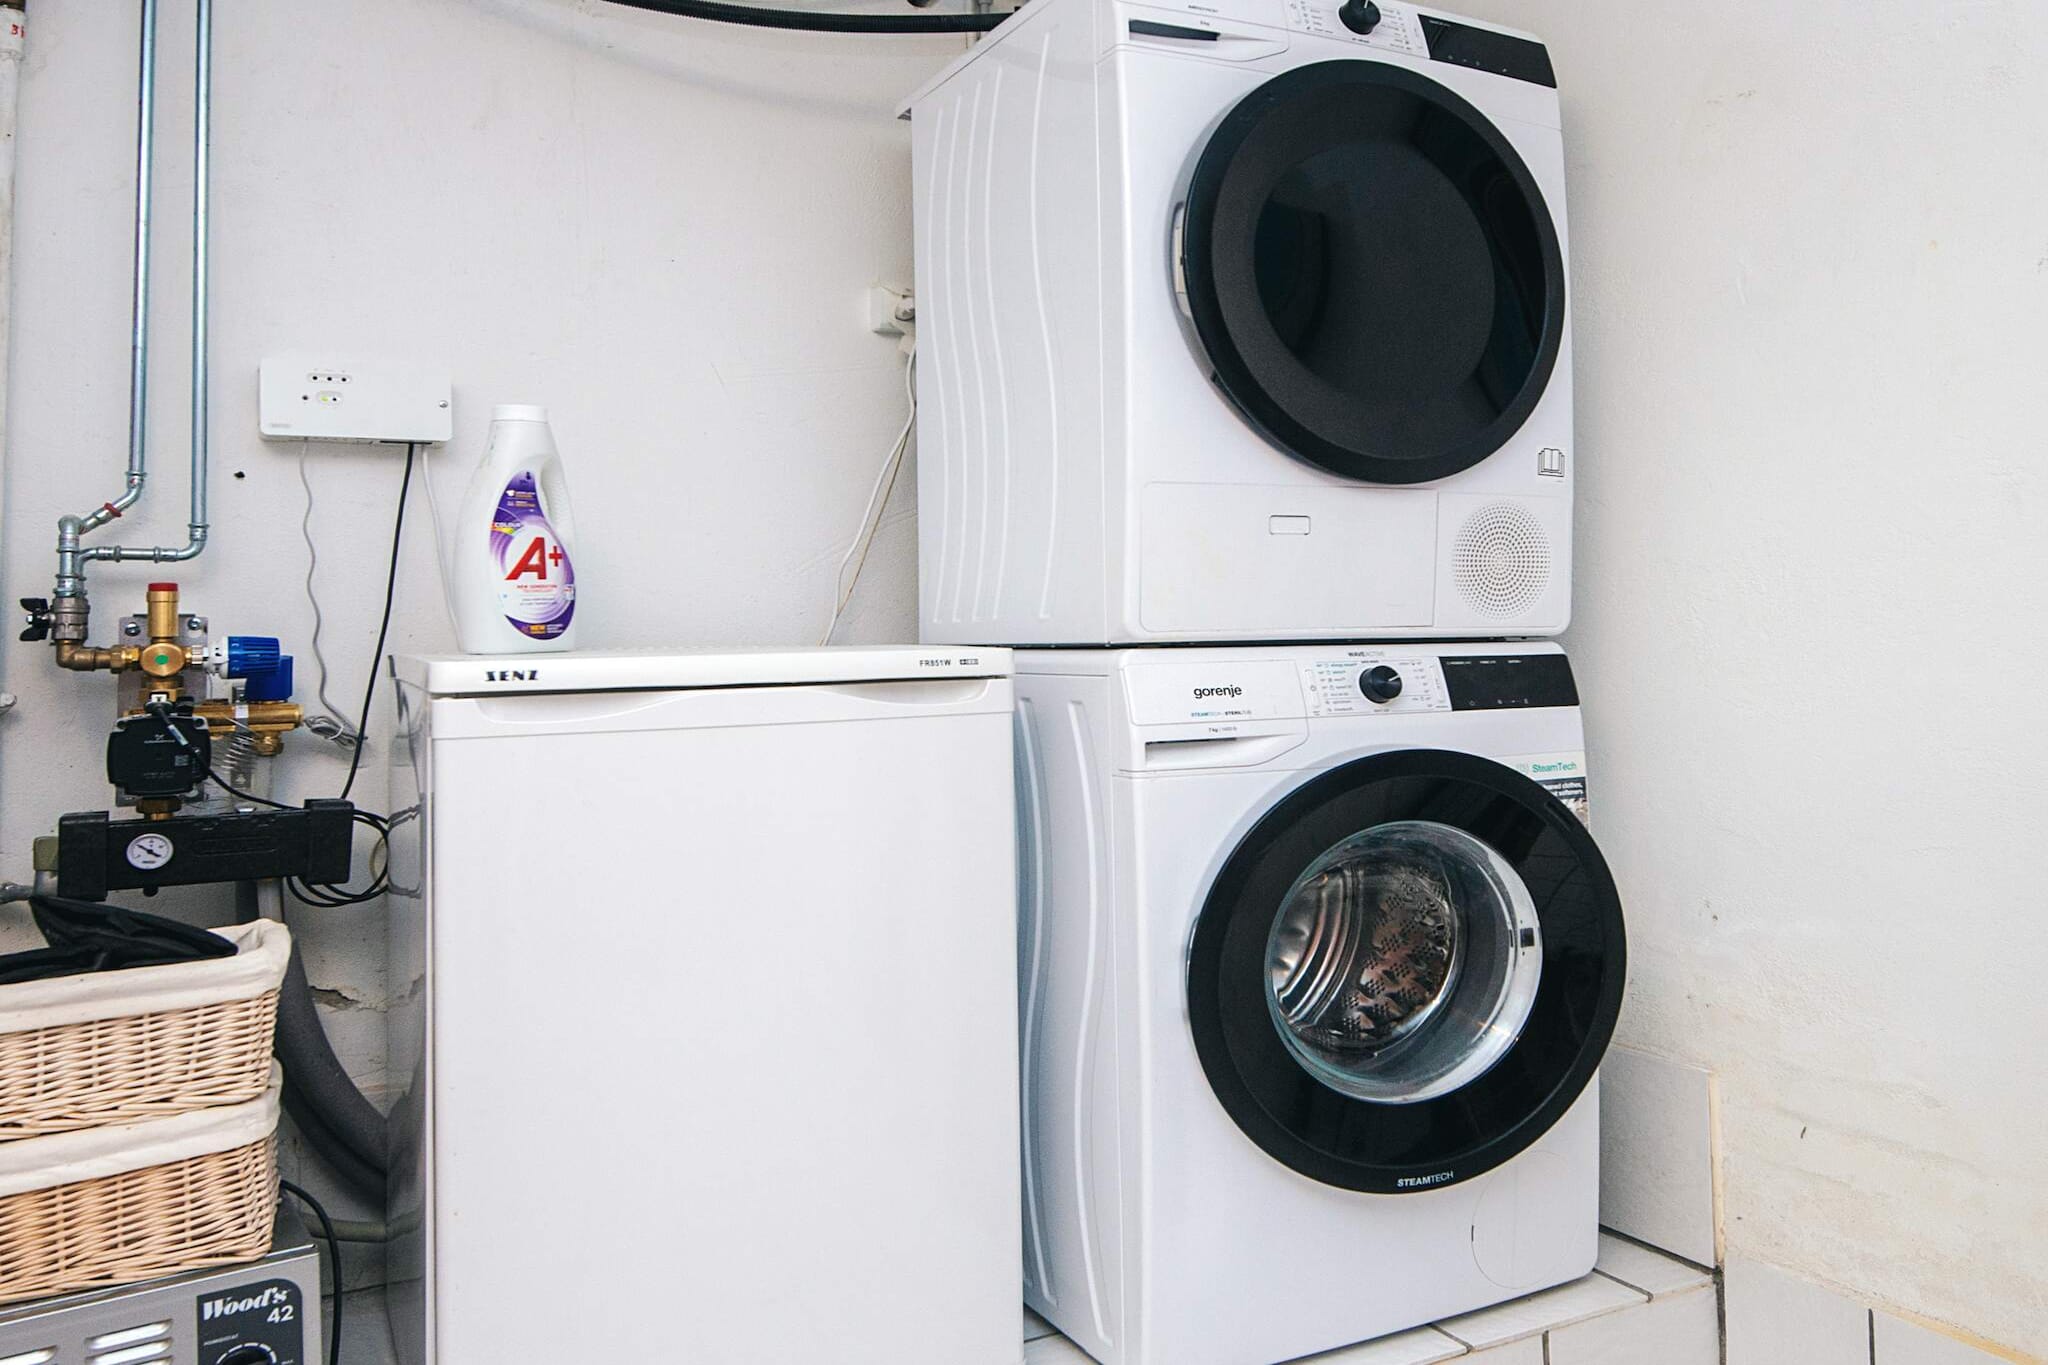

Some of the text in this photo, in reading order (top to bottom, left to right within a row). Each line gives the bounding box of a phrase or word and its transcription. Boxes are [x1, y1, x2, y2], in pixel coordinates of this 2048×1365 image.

[505, 537, 563, 580] A+
[919, 658, 952, 667] FR851W
[485, 669, 539, 682] SENZ
[1193, 684, 1243, 699] gorenje
[1532, 761, 1576, 773] SteamTech
[1397, 1171, 1454, 1187] STEAMTECH
[203, 1286, 289, 1321] Wood's
[266, 1304, 294, 1324] 42
